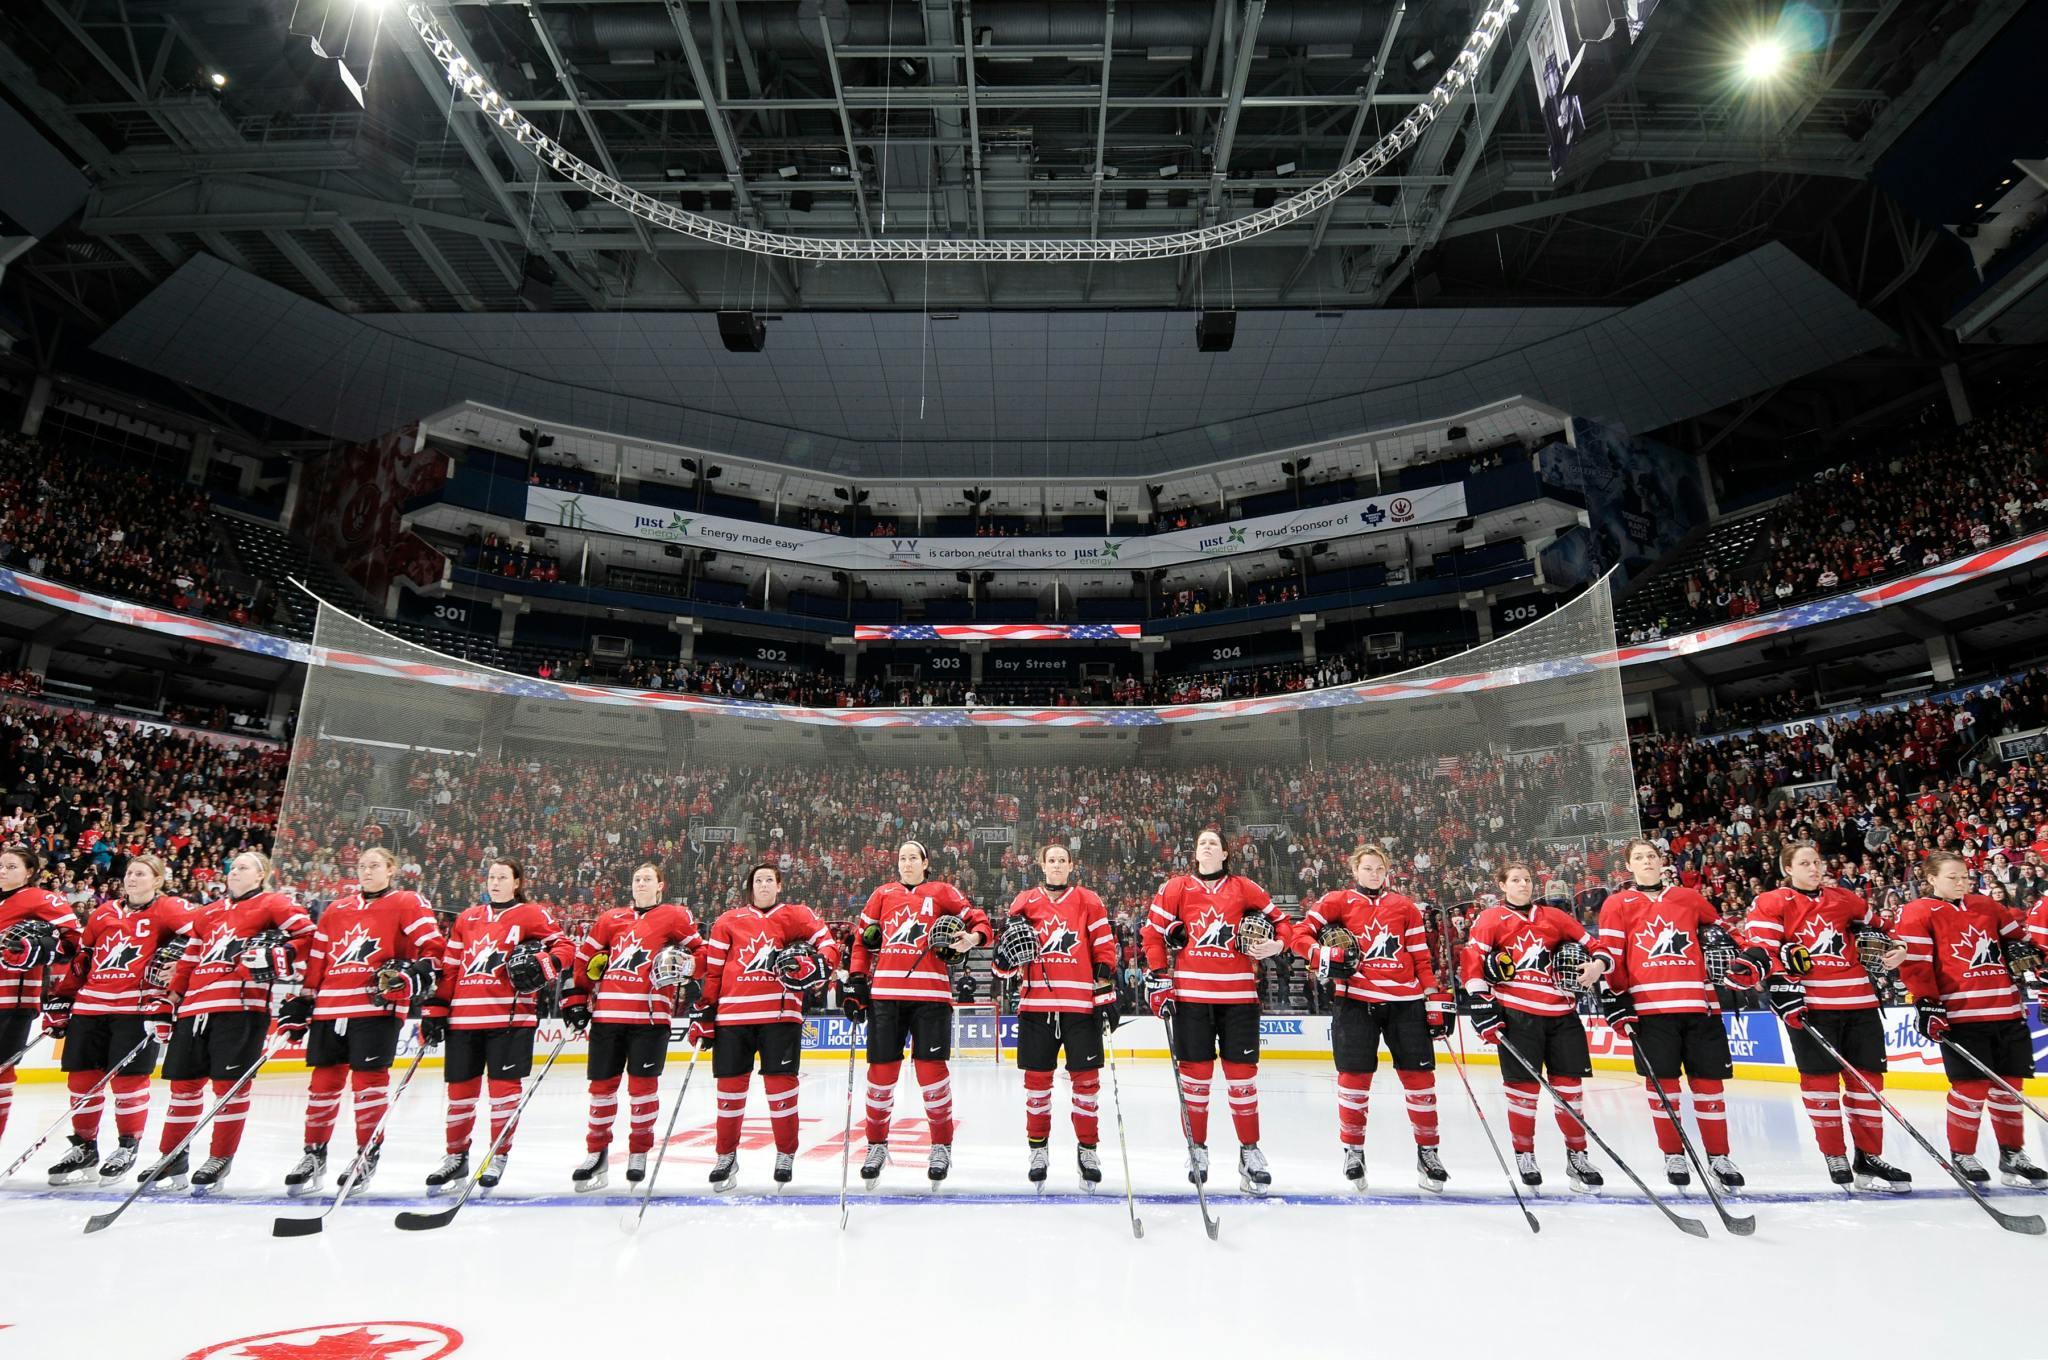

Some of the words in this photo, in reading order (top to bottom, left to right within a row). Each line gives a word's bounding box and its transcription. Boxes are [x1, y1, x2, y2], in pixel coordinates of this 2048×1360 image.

[635, 516, 664, 528] just
[1255, 527, 1287, 539] Proud
[1290, 518, 1333, 537] sponsor
[1336, 514, 1349, 526] of
[641, 527, 680, 540] energy
[701, 526, 739, 542] Energy
[742, 533, 772, 546] made
[1199, 536, 1223, 551] just
[1206, 542, 1239, 555] energy
[929, 548, 937, 557] is
[939, 548, 974, 557] carbon
[977, 548, 1015, 557] neutral
[1018, 548, 1052, 557] thanks
[1055, 549, 1066, 557] to
[1074, 548, 1098, 560] just
[1080, 558, 1111, 567] energy
[433, 604, 466, 622] 301
[1503, 604, 1538, 622] 305
[757, 648, 787, 661] 302
[1212, 646, 1242, 660] 304
[932, 658, 960, 669] 303
[995, 659, 1020, 671] Bay
[1026, 658, 1067, 669] Street
[708, 829, 732, 840] IBM
[920, 896, 934, 917] A
[135, 919, 150, 938] C
[505, 925, 520, 946] A
[1188, 951, 1235, 959] CANADA
[1642, 959, 1696, 968] CANADA
[328, 966, 375, 976] CANADA
[1963, 969, 2008, 978] CANAD
[460, 978, 502, 986] CANADA
[603, 974, 644, 983] CANADA
[1514, 974, 1553, 983] ANADA
[1770, 985, 1806, 993] BAUE
[953, 1024, 1019, 1038] TELUS
[1728, 1015, 1749, 1040] AY
